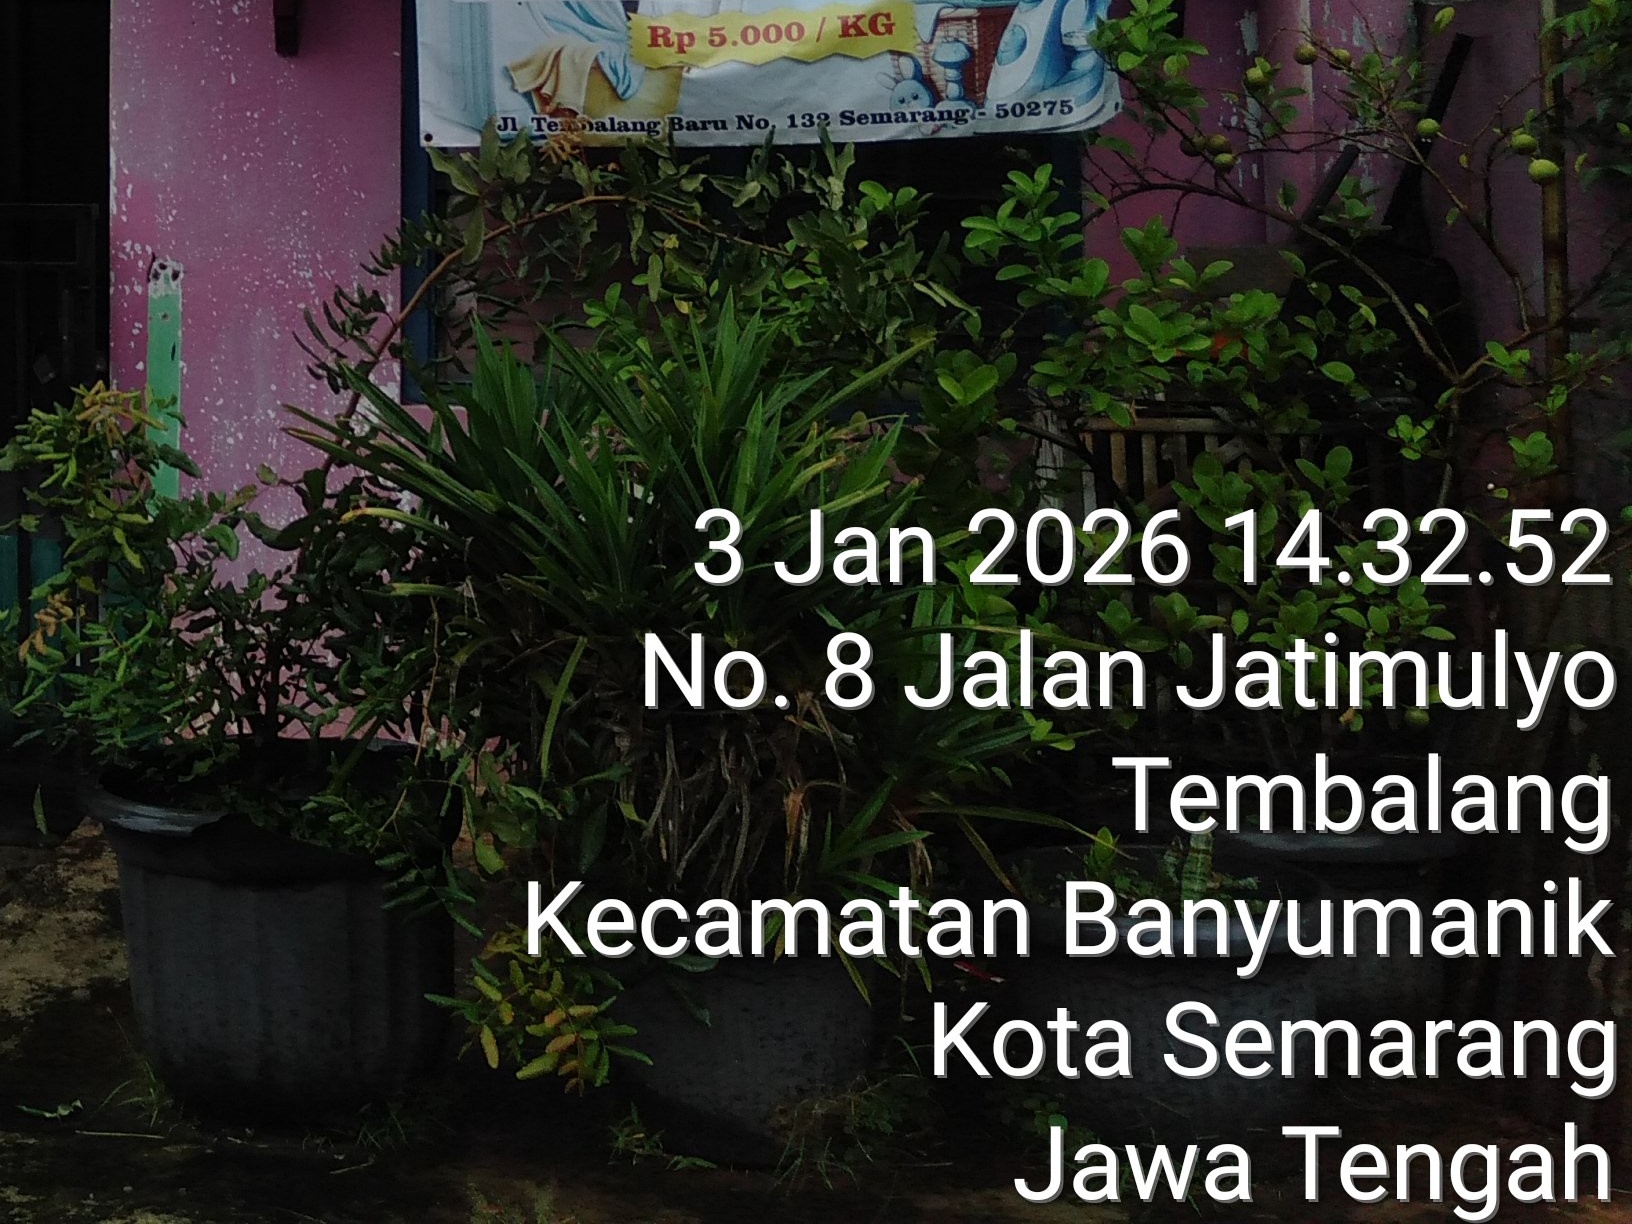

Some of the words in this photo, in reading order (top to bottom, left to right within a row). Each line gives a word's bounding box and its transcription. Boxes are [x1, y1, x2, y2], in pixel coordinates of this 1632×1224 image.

[647, 26, 695, 57] Rp
[708, 20, 805, 49] 5.000
[837, 12, 896, 40] KG
[670, 116, 728, 131] Baru
[840, 107, 970, 126] Semarang
[995, 99, 1074, 119] 50275
